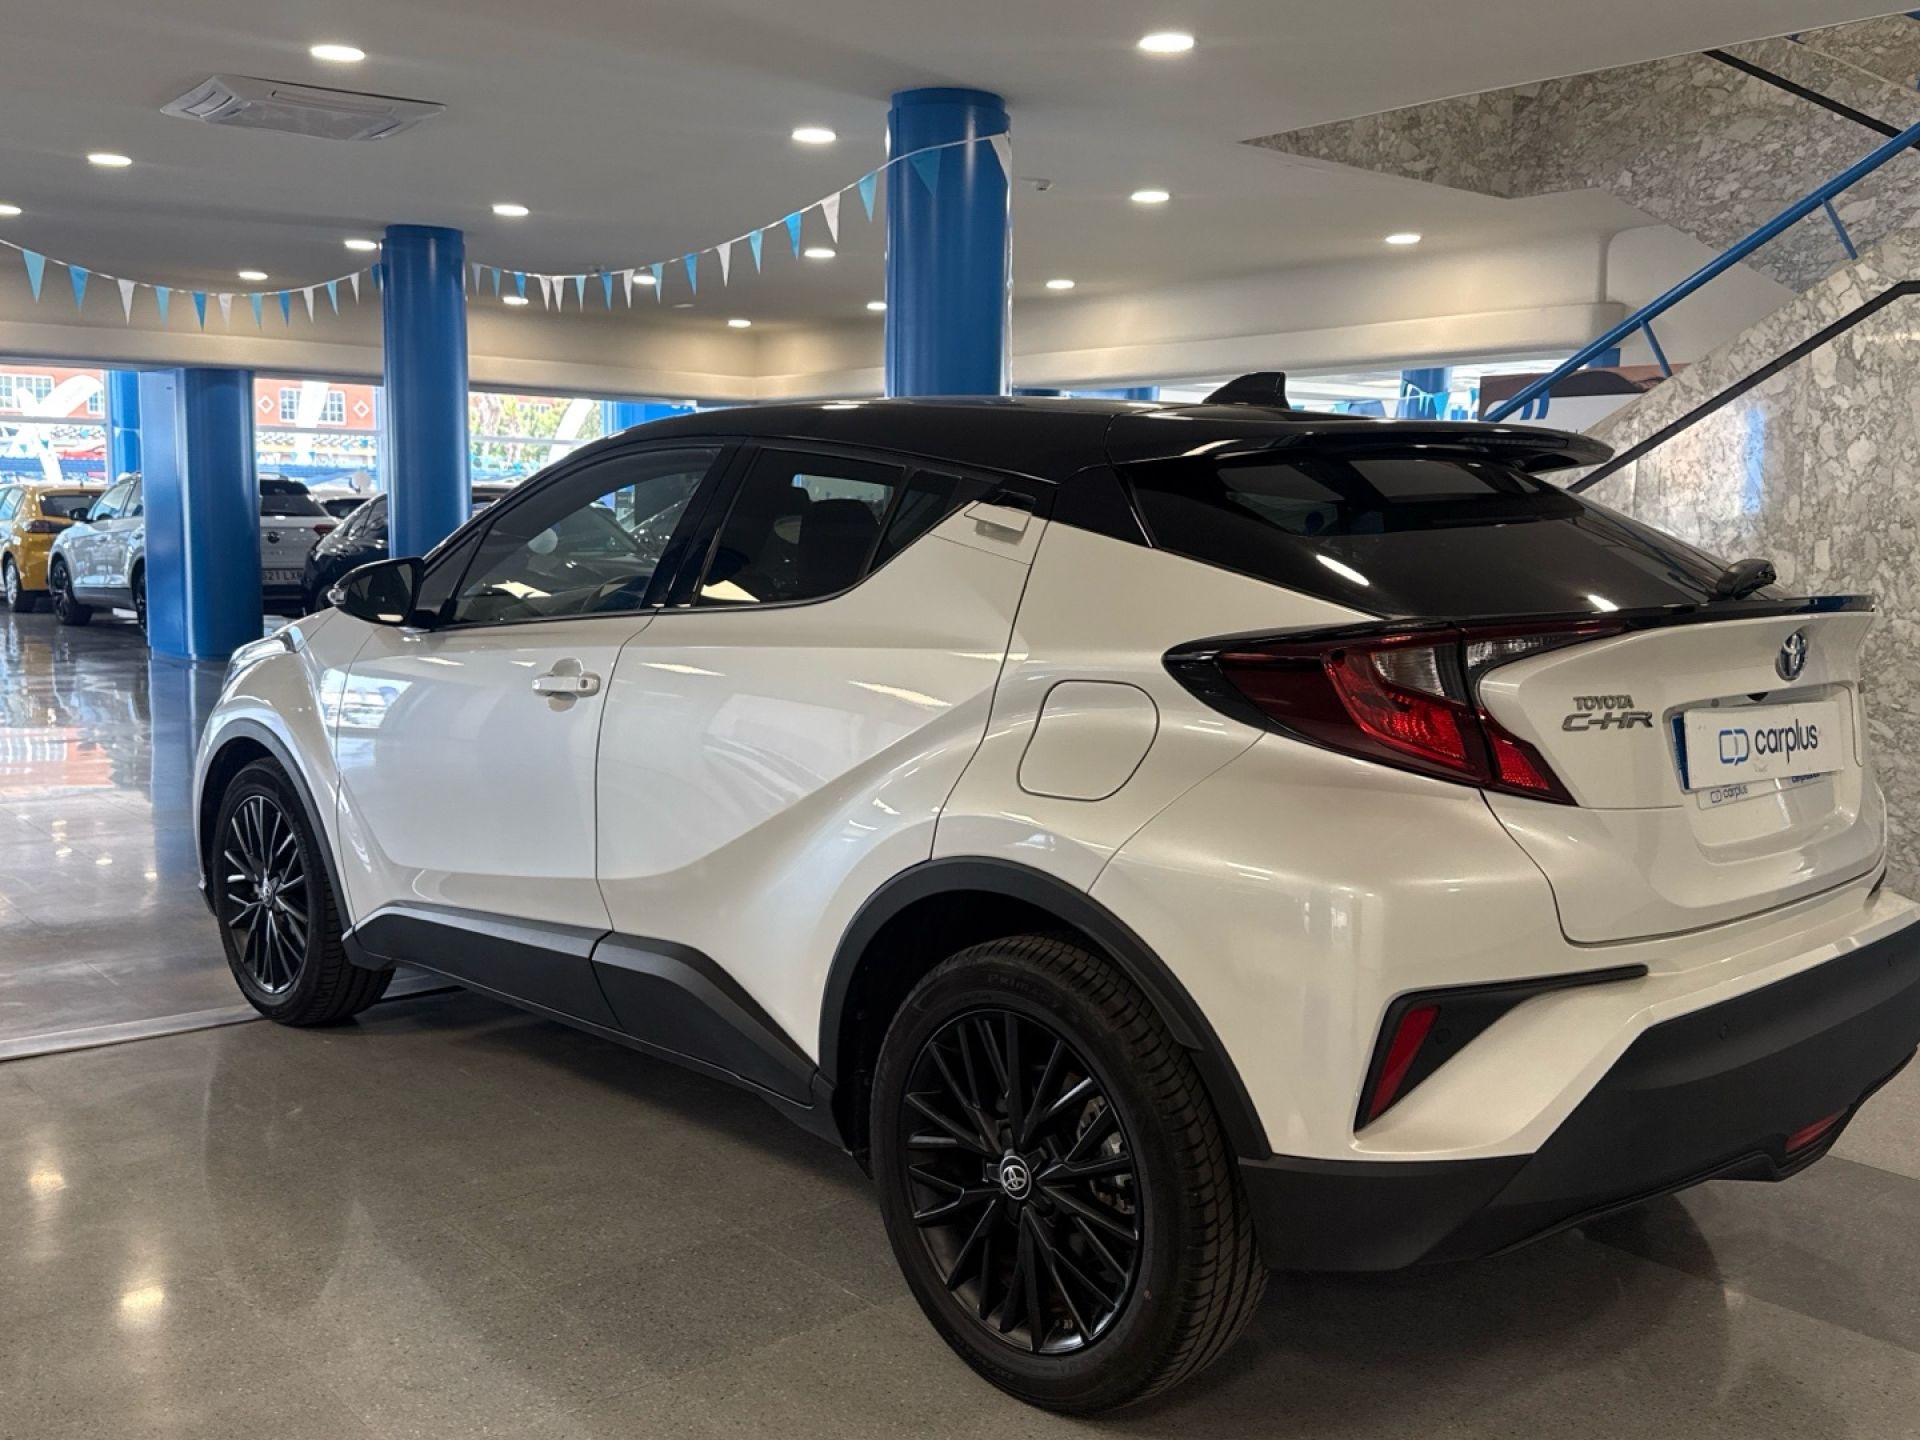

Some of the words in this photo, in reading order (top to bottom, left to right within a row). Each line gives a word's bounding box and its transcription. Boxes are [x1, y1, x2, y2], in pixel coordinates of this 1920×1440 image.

[1573, 695, 1634, 710] TOYOTA
[1562, 711, 1653, 731] C-HR
[1755, 719, 1818, 763] carplus
[1723, 784, 1748, 799] carplus
